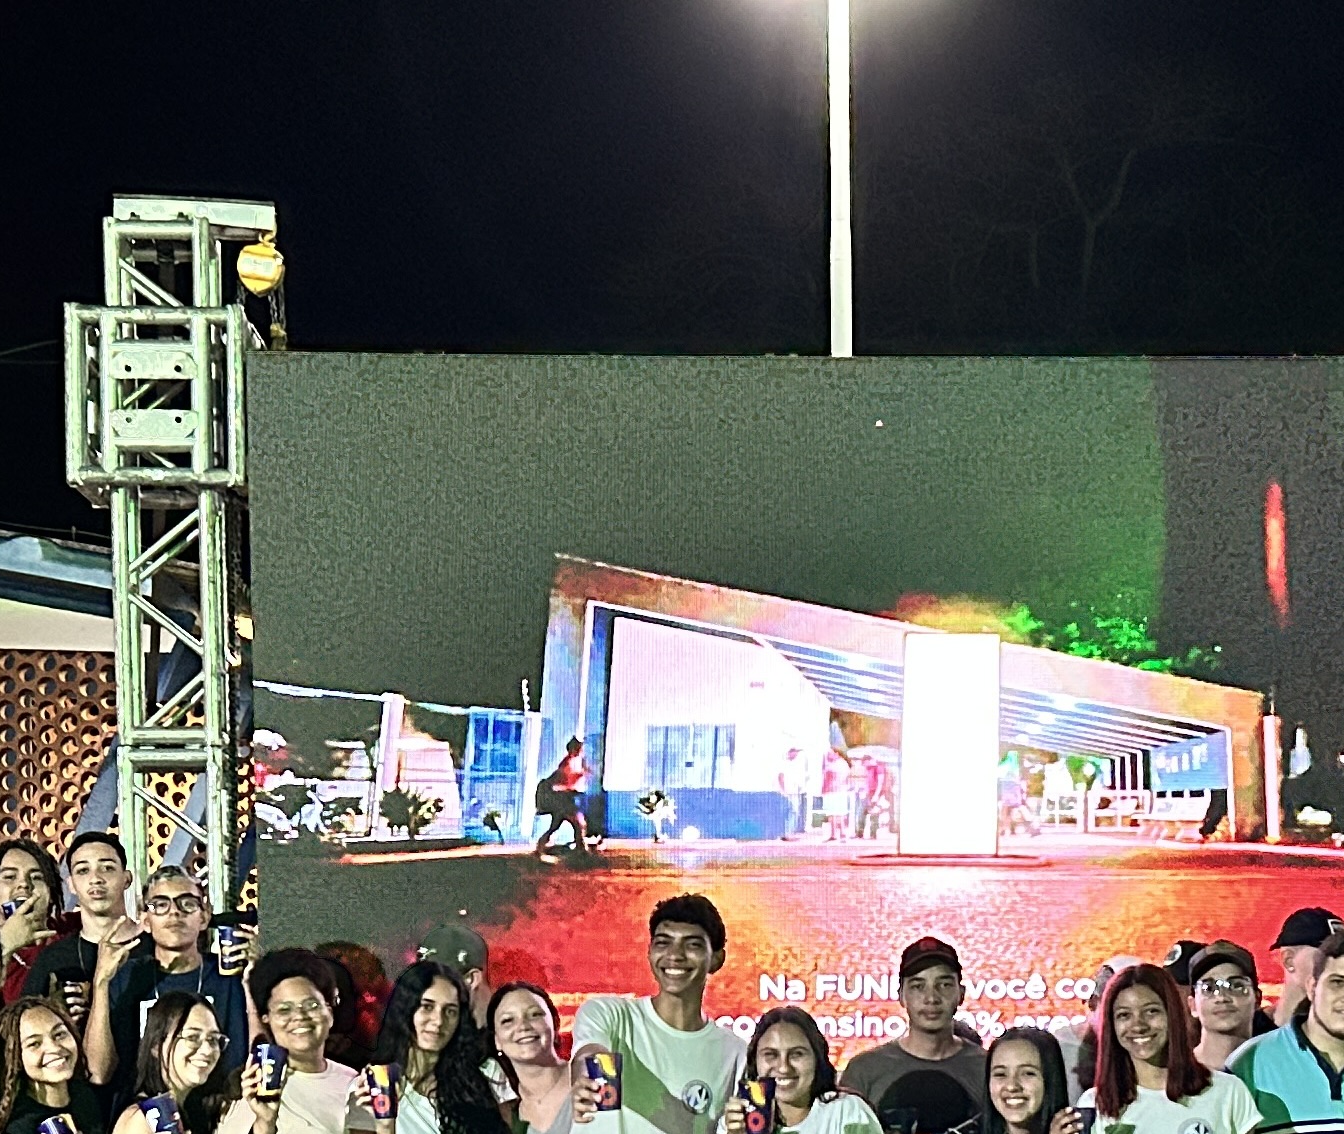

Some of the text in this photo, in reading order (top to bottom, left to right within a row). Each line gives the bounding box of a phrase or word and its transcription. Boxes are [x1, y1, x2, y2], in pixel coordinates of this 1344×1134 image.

[759, 974, 805, 1000] Na
[965, 973, 1045, 1000] você
[816, 1010, 907, 1038] nsino
